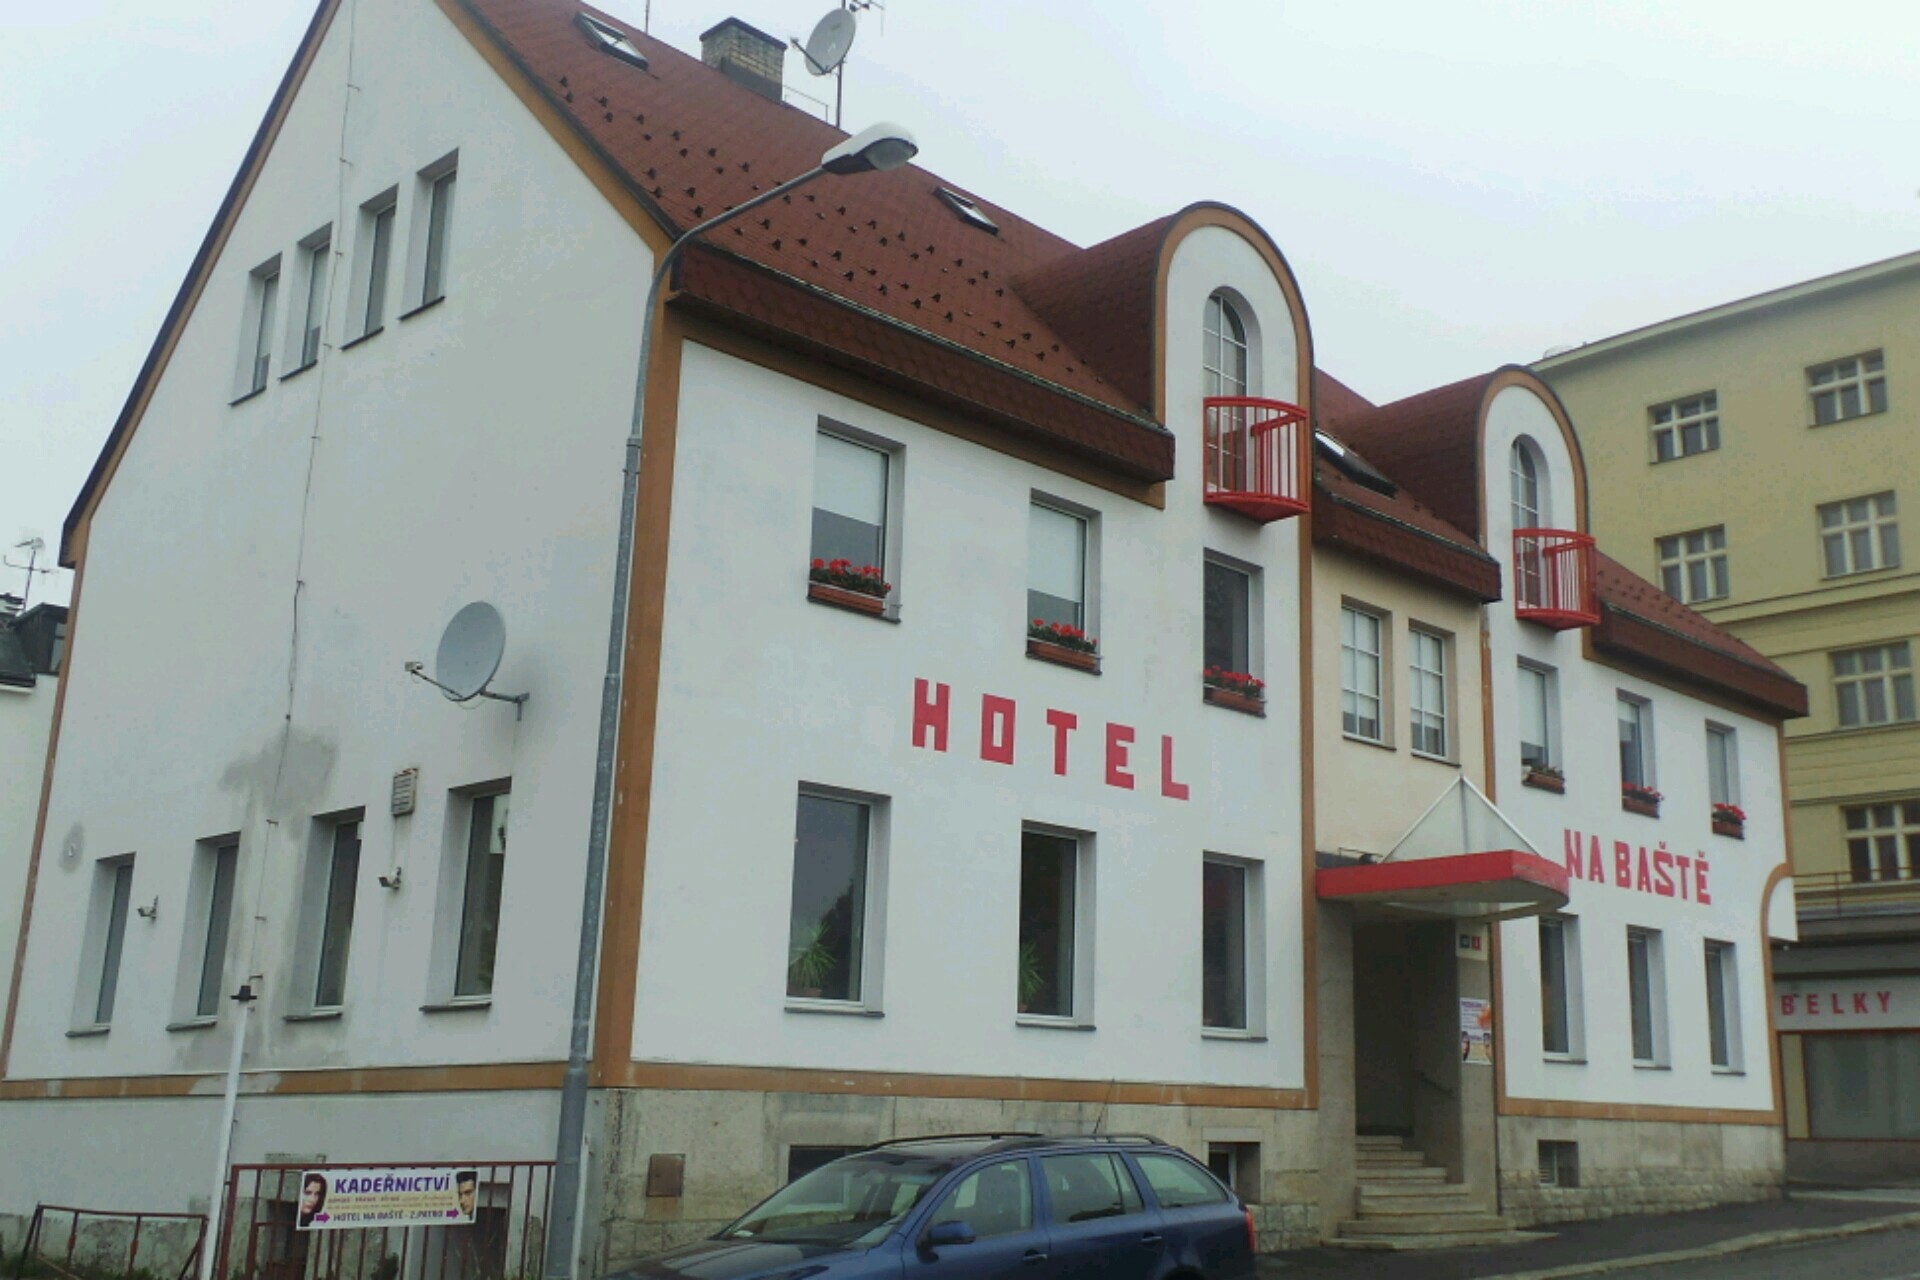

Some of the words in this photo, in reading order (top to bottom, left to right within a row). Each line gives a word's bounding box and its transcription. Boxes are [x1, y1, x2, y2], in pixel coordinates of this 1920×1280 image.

[912, 677, 1190, 801] HOTEL
[1564, 828, 1605, 884] NA
[1614, 841, 1712, 906] BAŠTĚ
[1780, 990, 1891, 1016] BELKY
[335, 1173, 451, 1194] KADEŘNICTVÍ
[333, 1212, 360, 1221] HOTEL
[363, 1211, 376, 1220] NA
